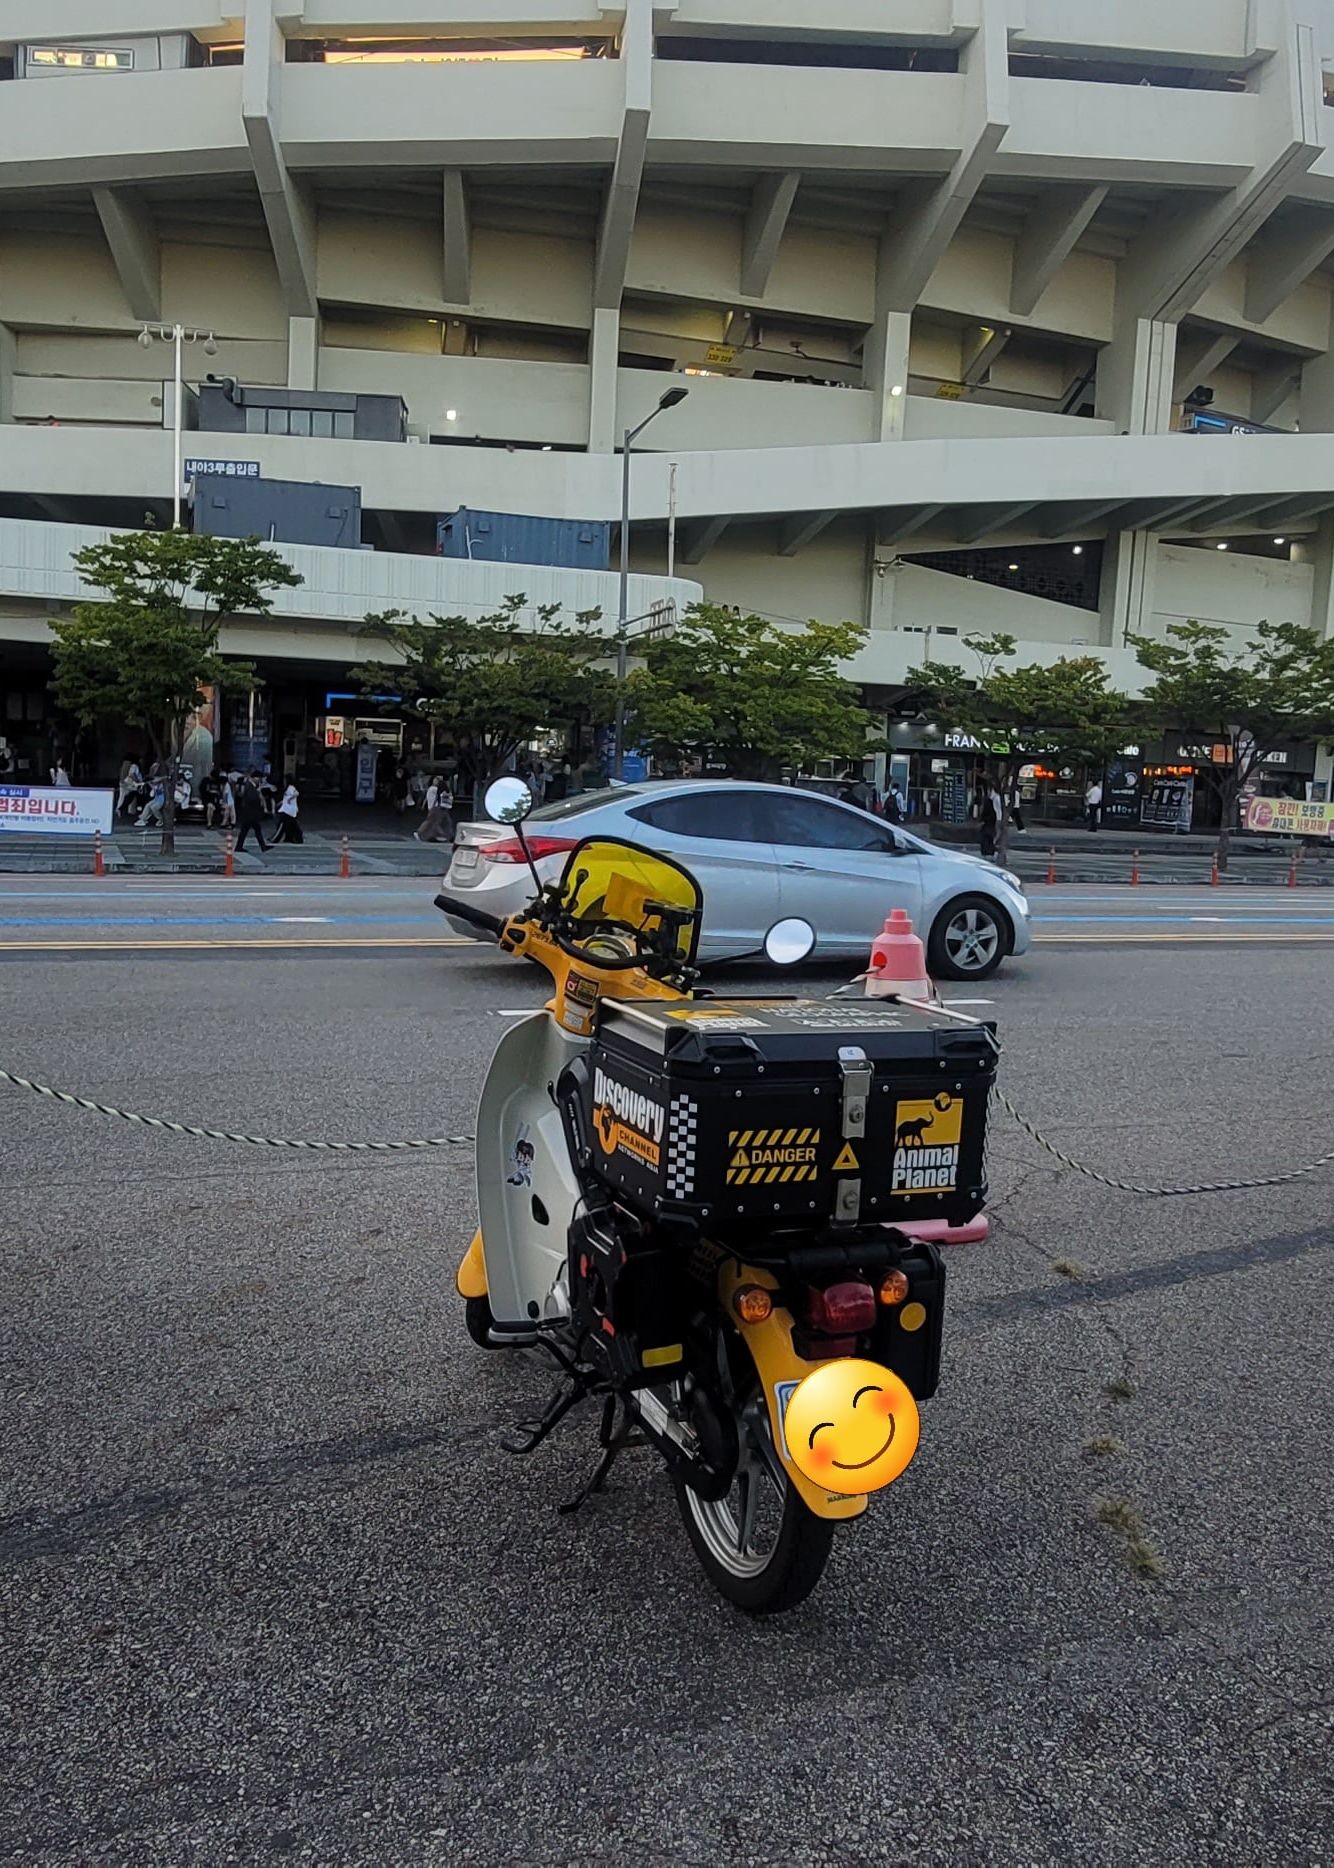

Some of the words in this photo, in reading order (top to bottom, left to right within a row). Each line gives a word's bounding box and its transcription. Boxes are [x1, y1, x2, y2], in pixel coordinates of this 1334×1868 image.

[186, 461, 259, 476] 내야3루출입문
[619, 1129, 657, 1160] CHANNEL
[751, 1147, 816, 1164] DANGER
[893, 1144, 960, 1169] Animal
[891, 1165, 958, 1190] Planet
